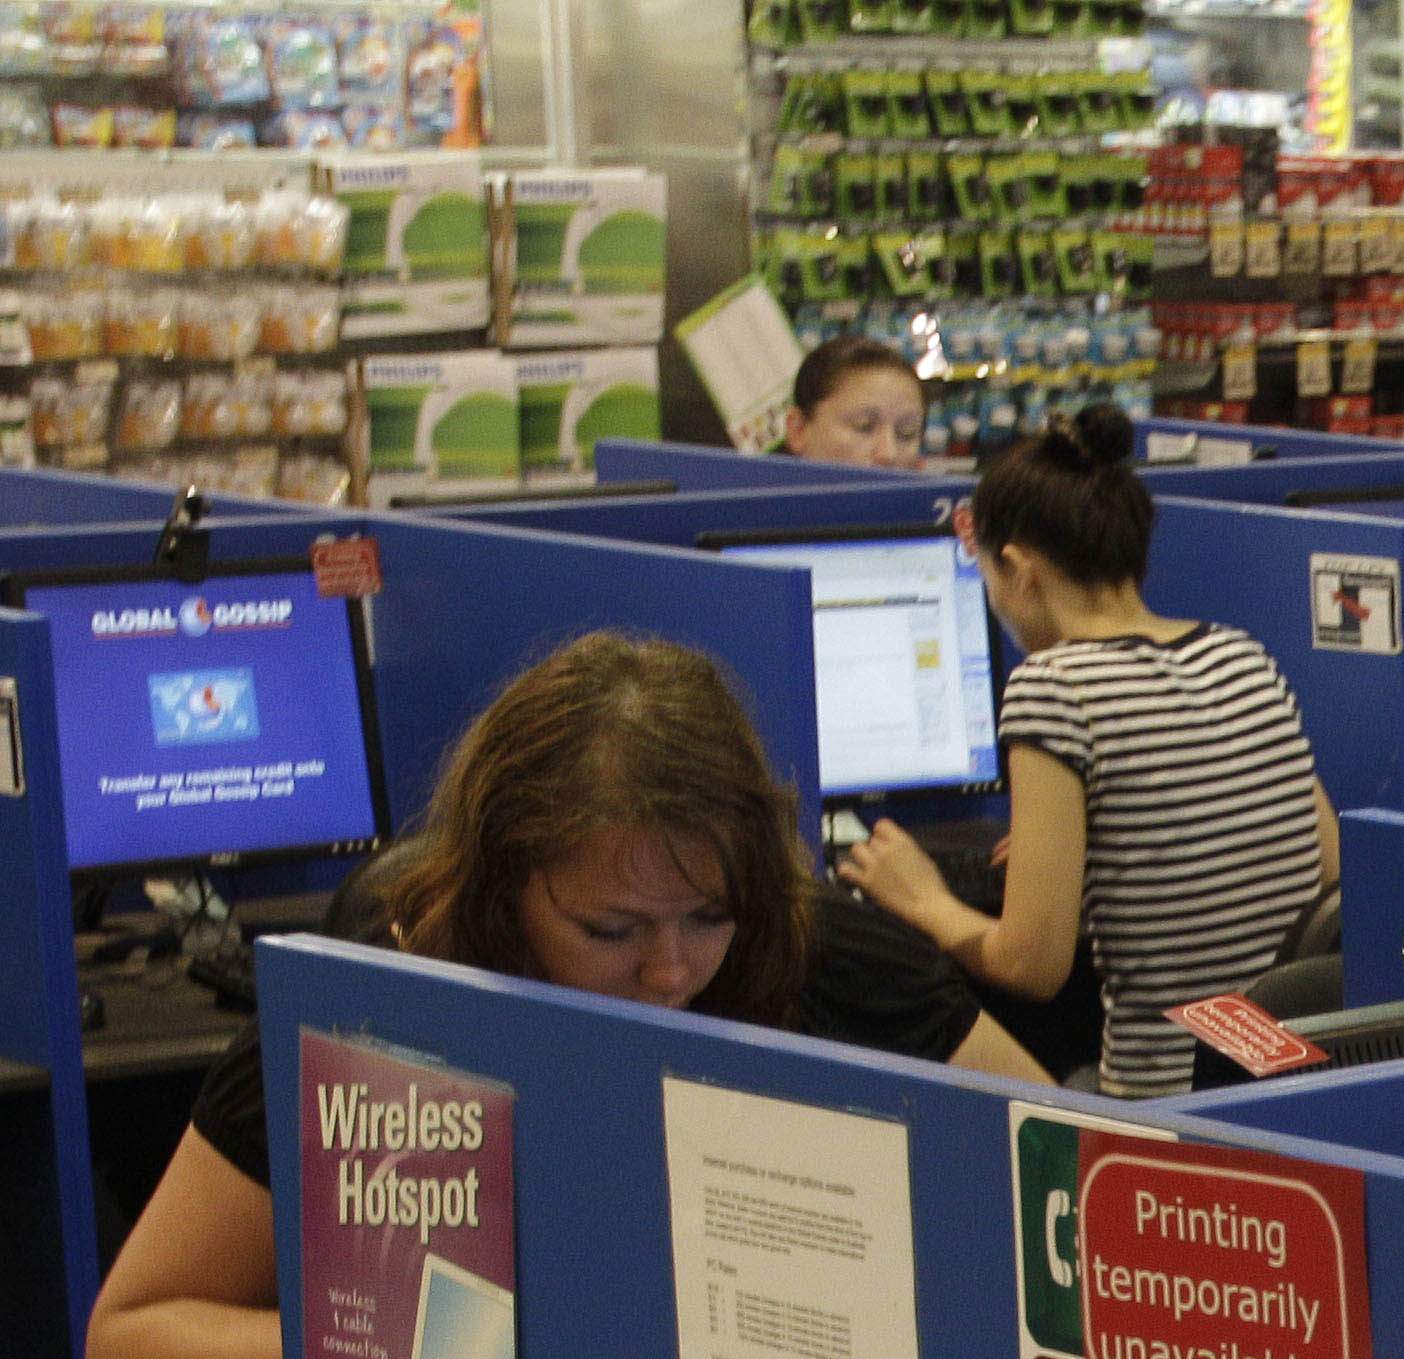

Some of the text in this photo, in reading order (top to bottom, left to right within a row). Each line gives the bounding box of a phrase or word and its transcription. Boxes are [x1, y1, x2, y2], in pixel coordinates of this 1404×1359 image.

[91, 599, 293, 634] GLOBAL GOSSIP
[317, 1082, 484, 1151] Wireless
[338, 1158, 479, 1245] Hotspot
[1135, 1190, 1287, 1268] Printing
[1093, 1254, 1320, 1345] temporarily
